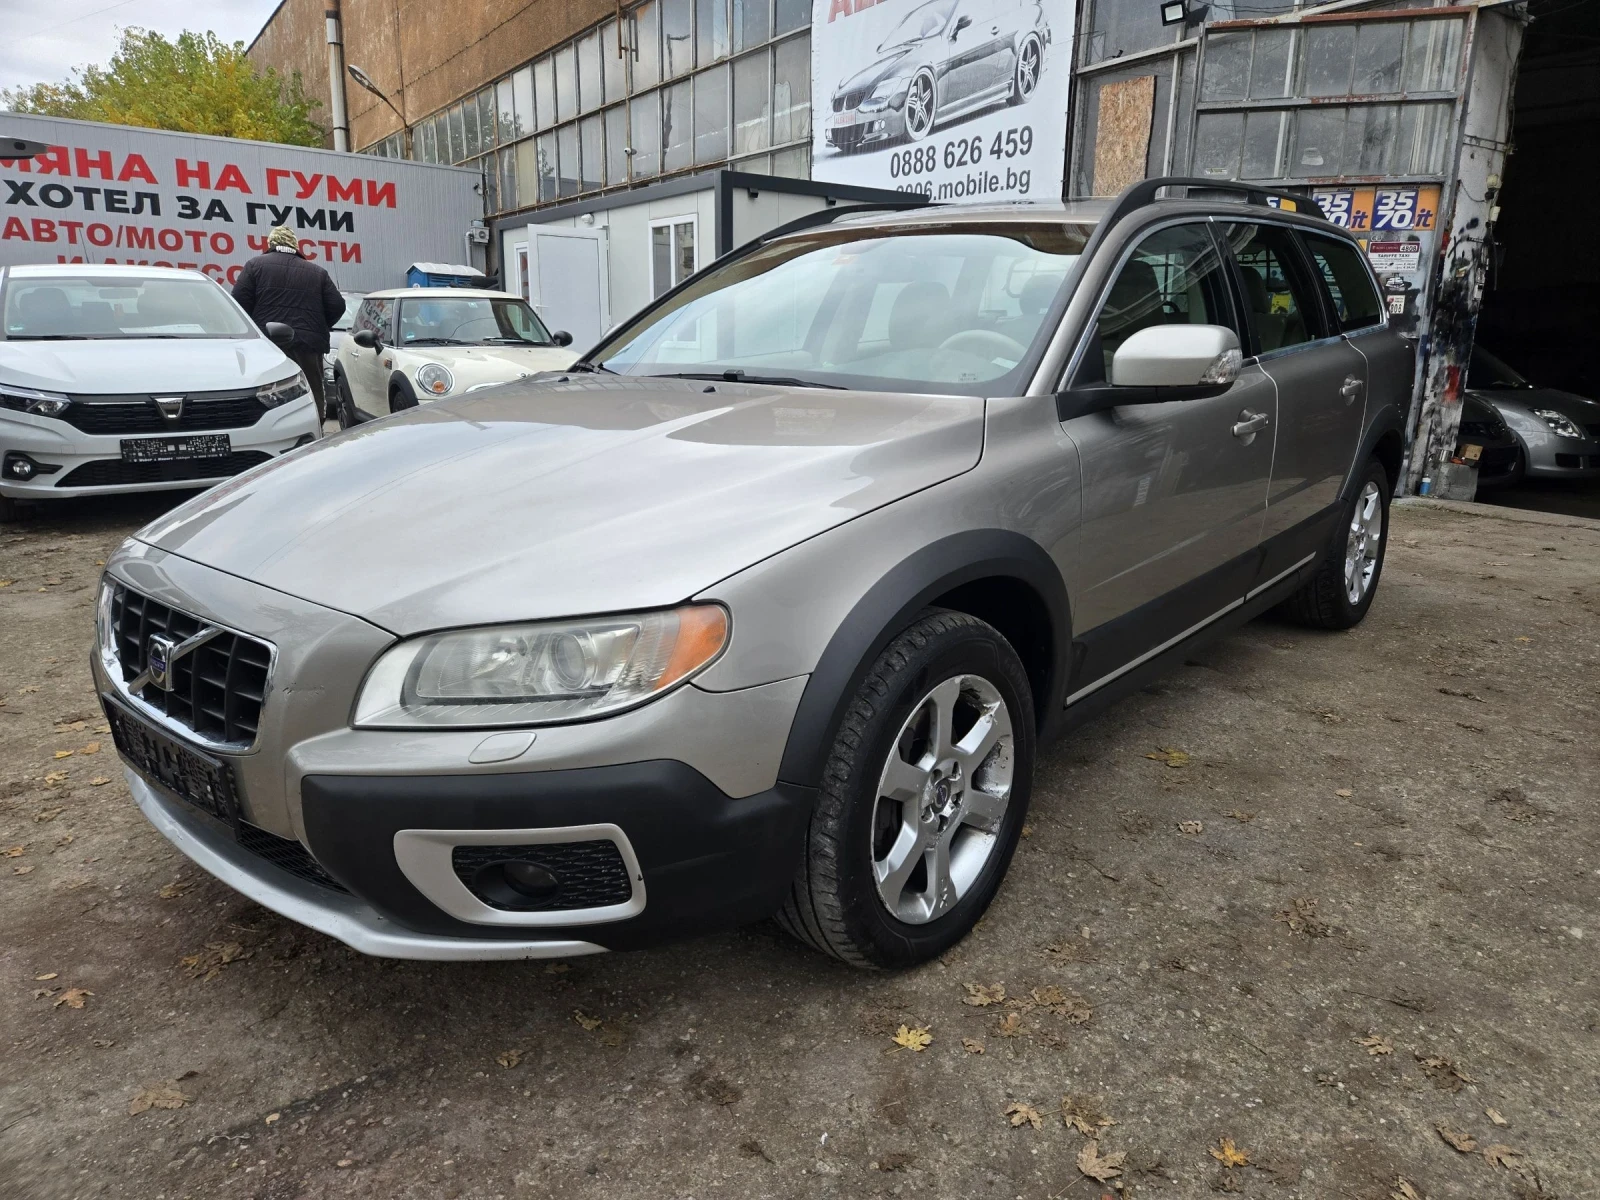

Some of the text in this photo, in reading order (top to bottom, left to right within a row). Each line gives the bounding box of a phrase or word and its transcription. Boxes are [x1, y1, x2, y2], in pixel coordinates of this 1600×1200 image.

[890, 125, 1033, 178] 0888 626 459
[3, 179, 354, 232] ХОТЕЛ ЗА ГУМИ
[175, 158, 252, 194] НА
[266, 168, 397, 208] ГУМИ
[1317, 193, 1352, 212] 35
[1377, 191, 1416, 210] 35
[2, 216, 362, 264] АВТО/МОТО ЧСТИ
